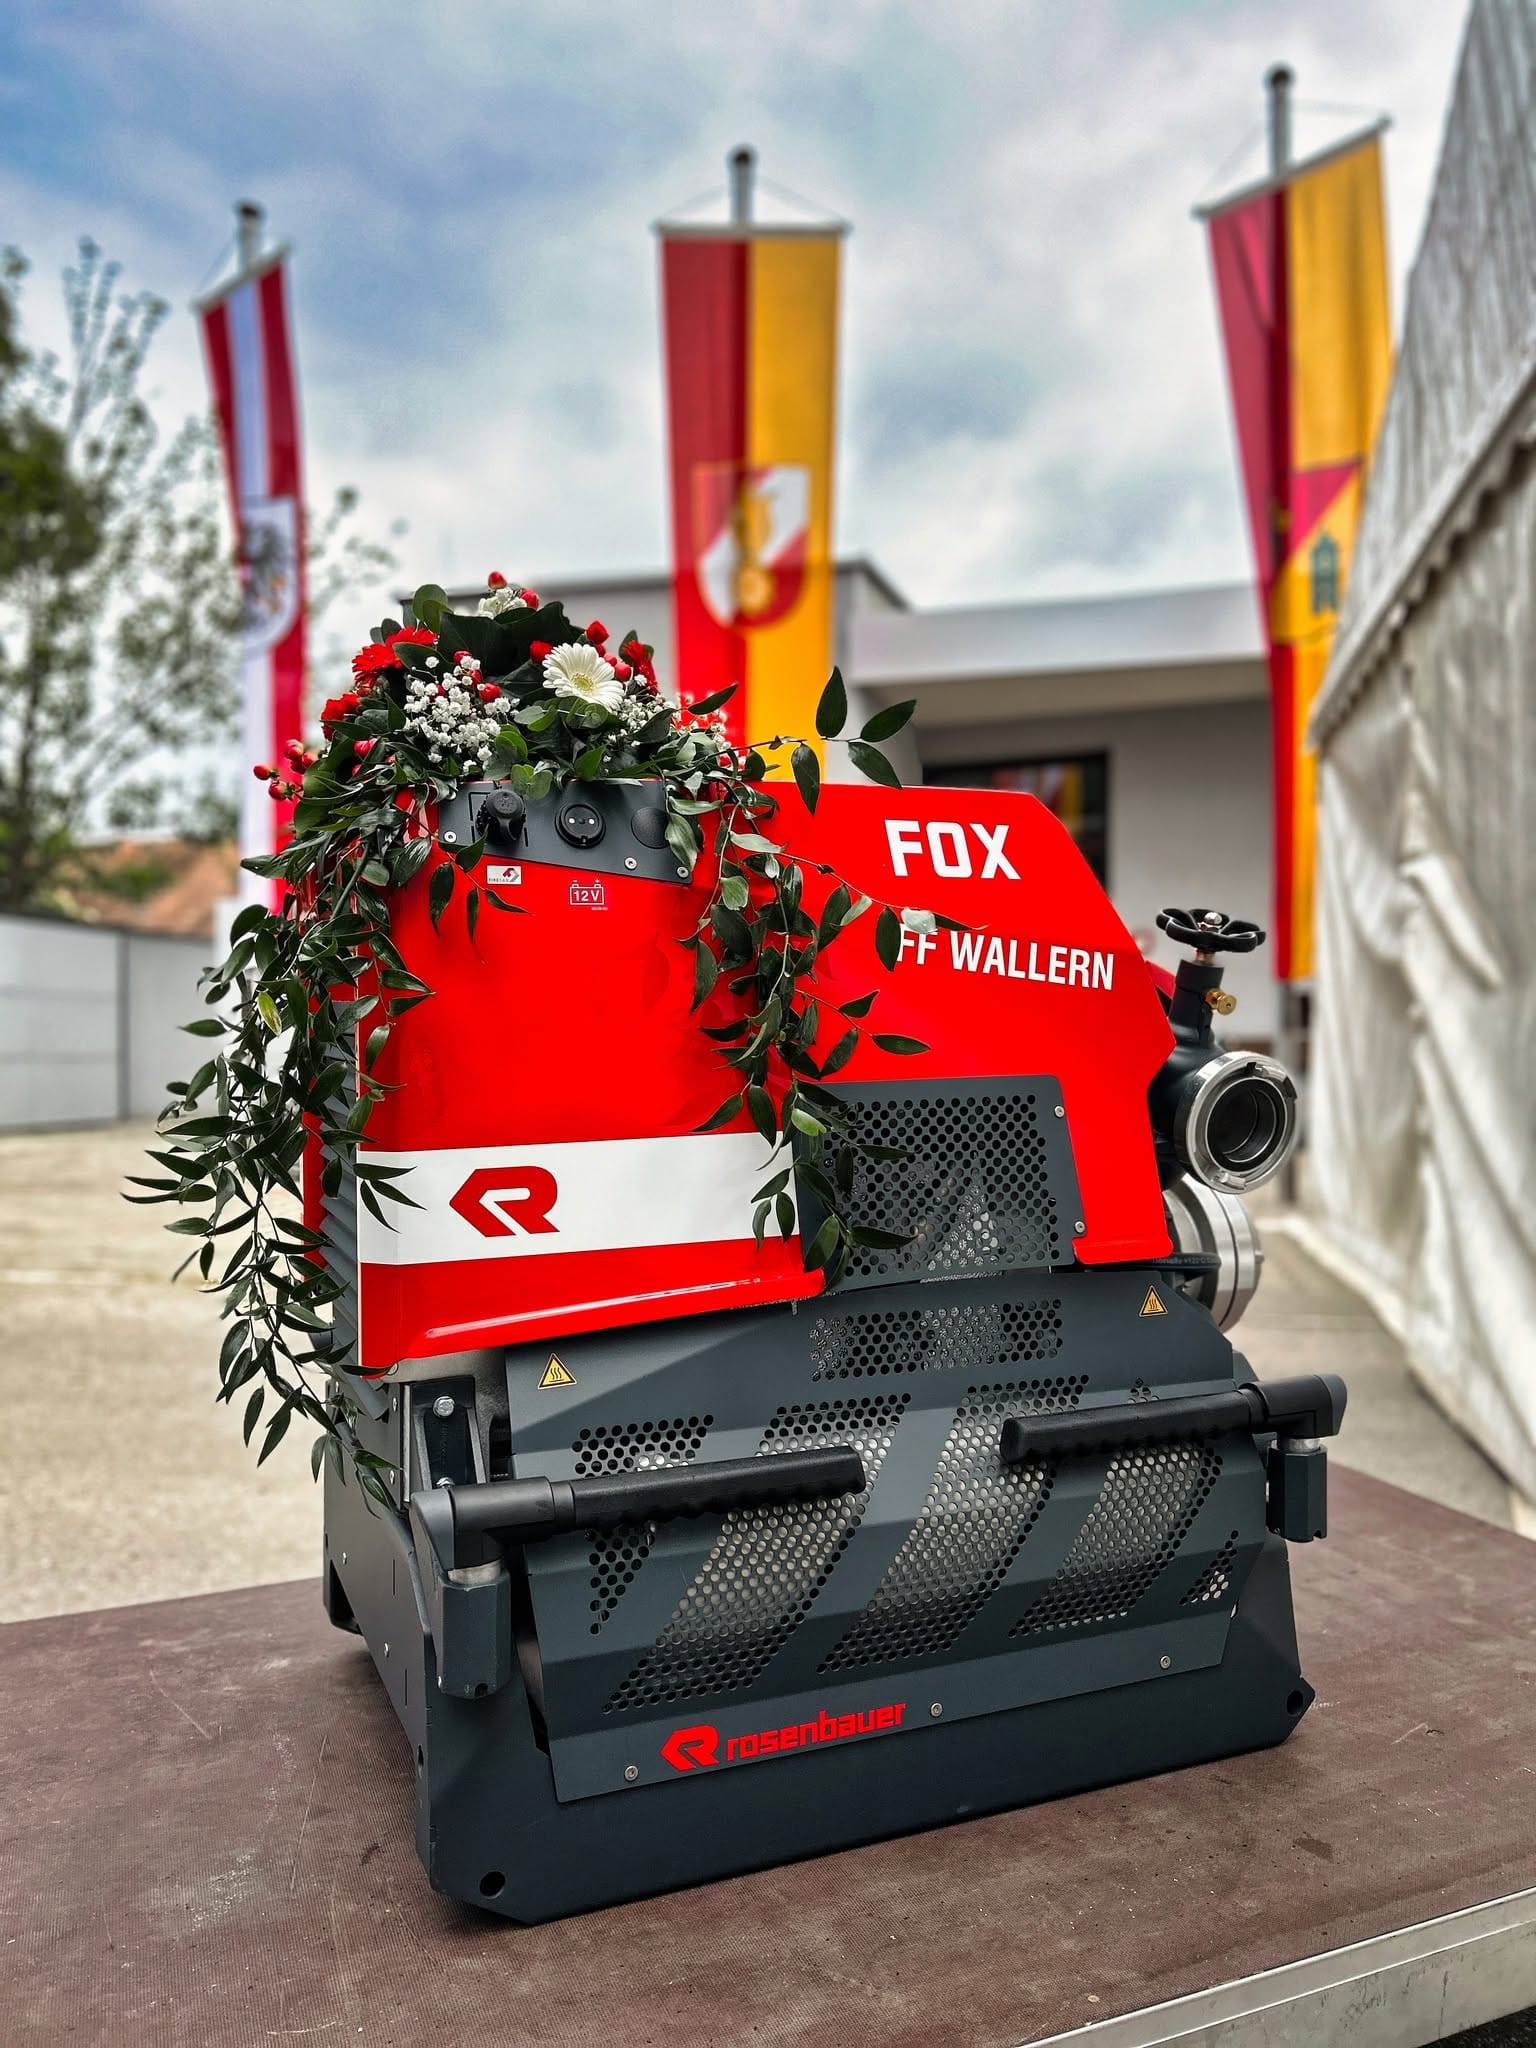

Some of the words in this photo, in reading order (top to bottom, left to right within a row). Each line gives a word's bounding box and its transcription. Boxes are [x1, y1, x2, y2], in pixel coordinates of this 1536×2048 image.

[884, 819, 1022, 880] FOX
[897, 923, 938, 965] FF
[950, 930, 1114, 991] WALLERN
[726, 1702, 906, 1761] rosenbauer
